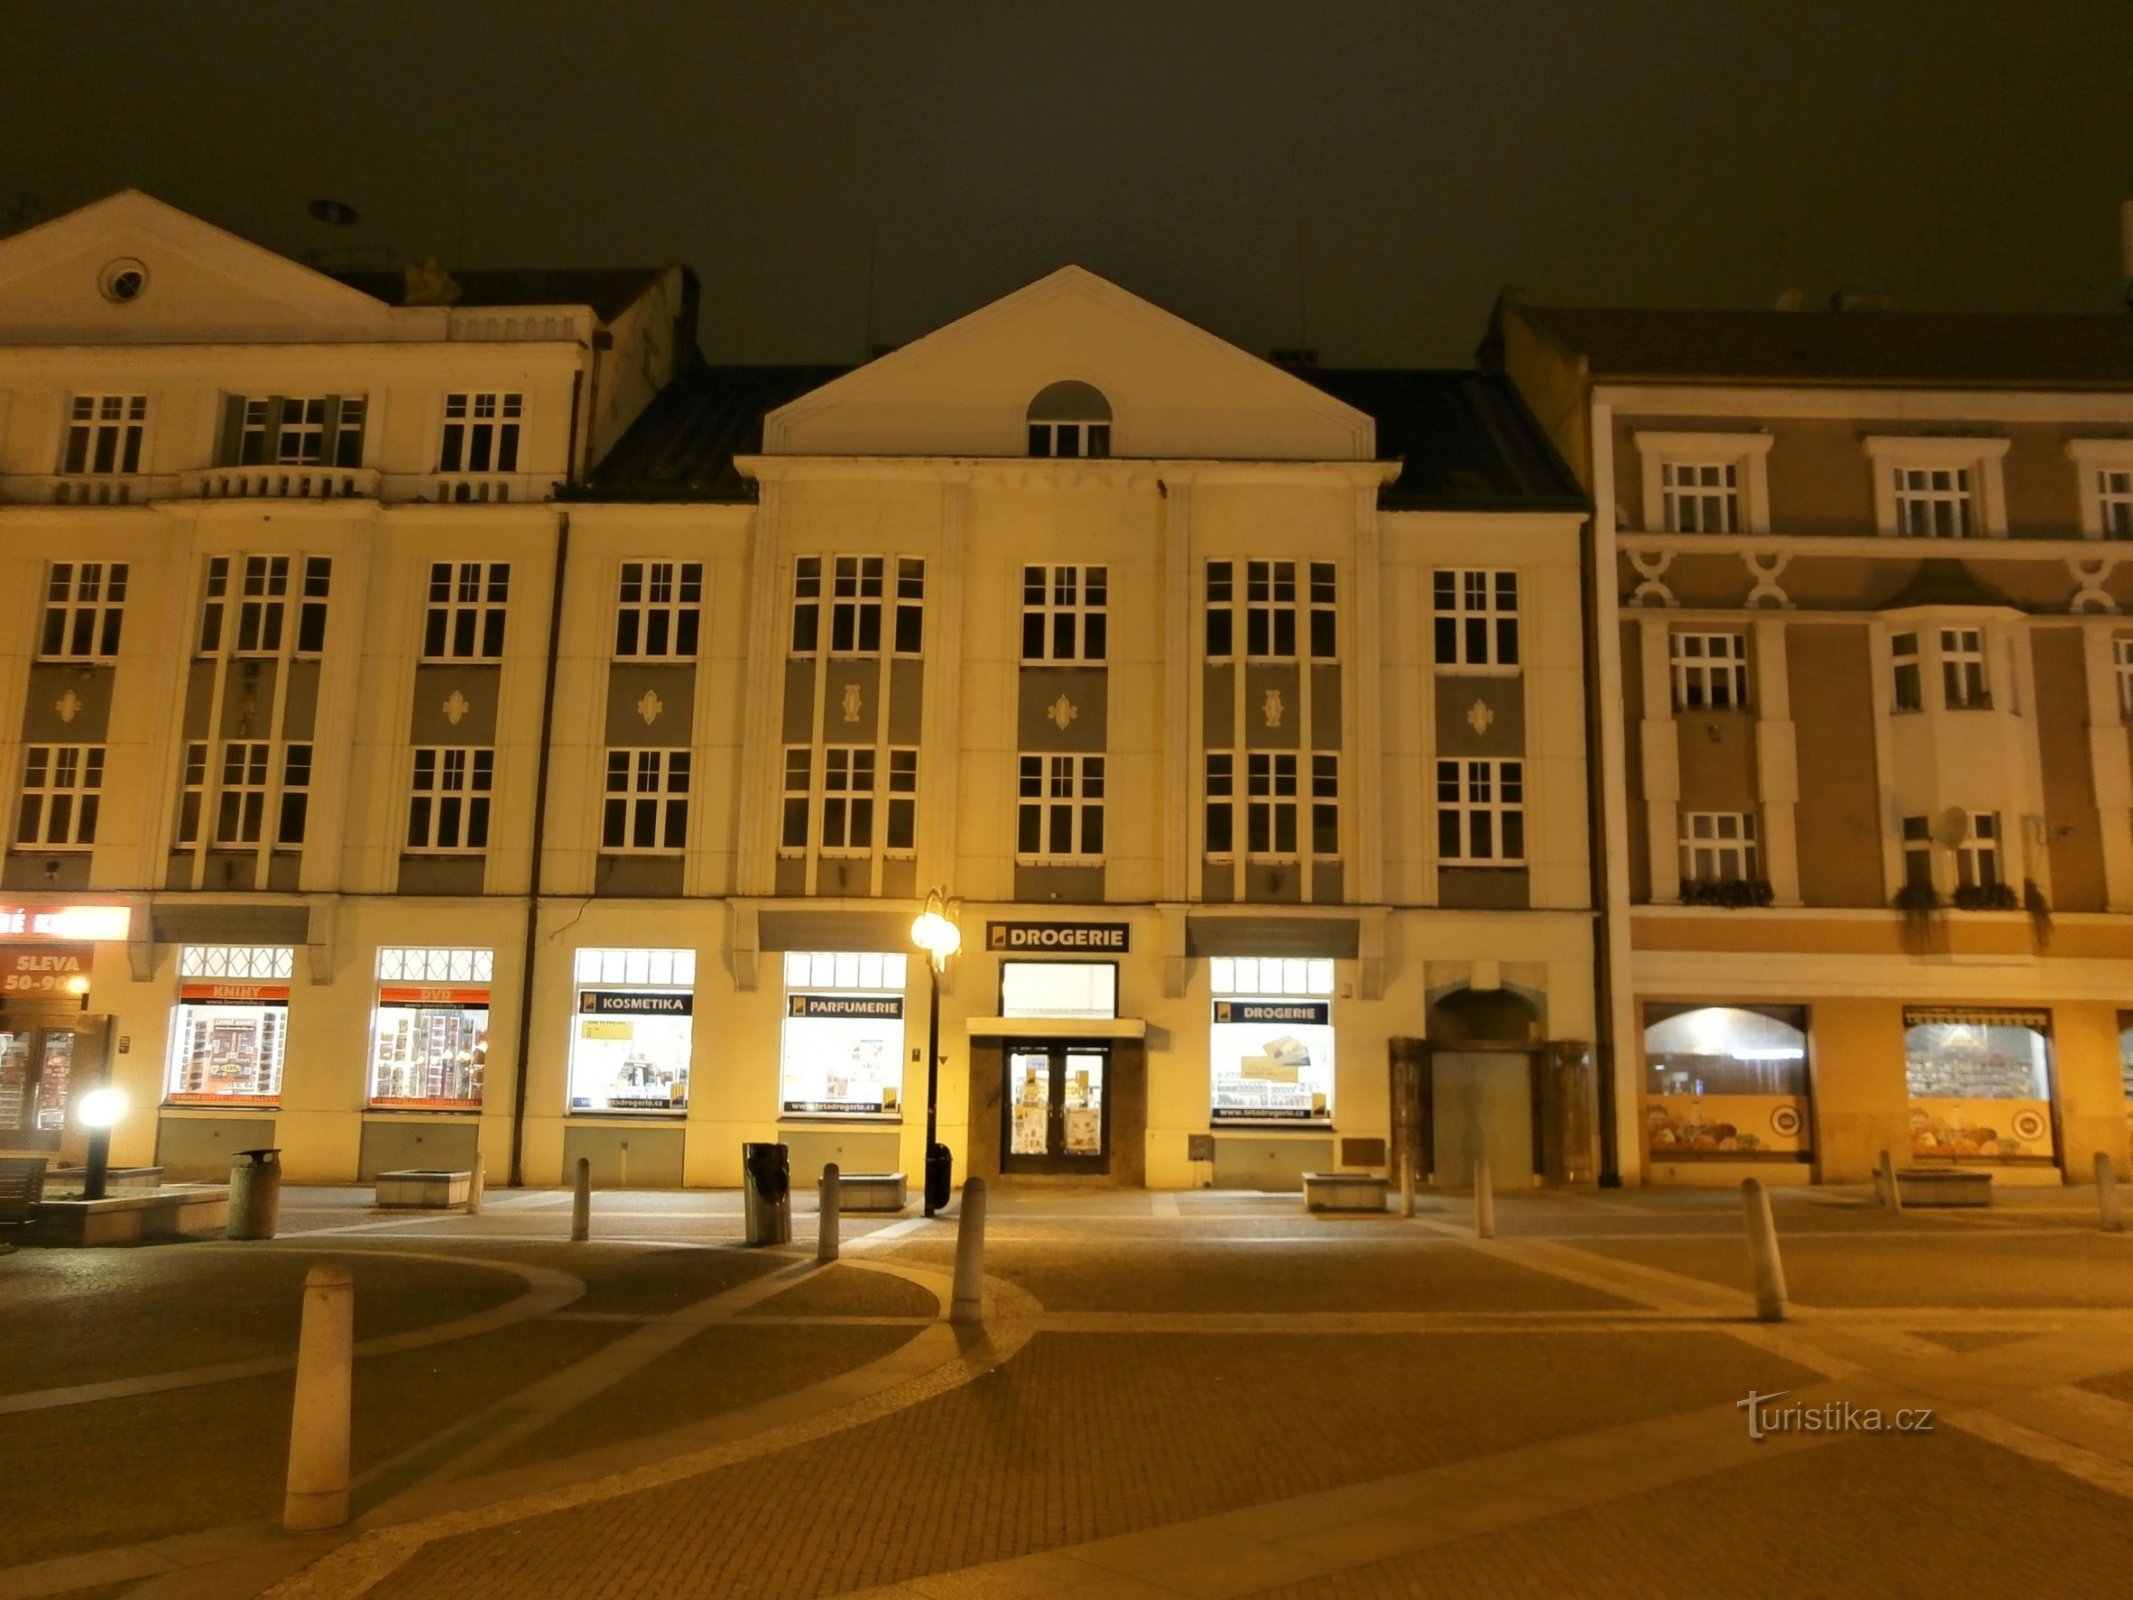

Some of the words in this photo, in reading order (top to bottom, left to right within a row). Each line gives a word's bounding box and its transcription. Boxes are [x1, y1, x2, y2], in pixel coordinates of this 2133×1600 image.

[1011, 929, 1123, 947] DROGERIE
[17, 956, 80, 972] SLEVA
[4, 975, 88, 991] 50-90
[213, 985, 261, 998] KNIHY
[421, 989, 452, 1001] DVD
[603, 998, 684, 1011] KOSMETIKA
[809, 1001, 899, 1015] PARFUMERIE
[1243, 1007, 1316, 1019] DROGERIE
